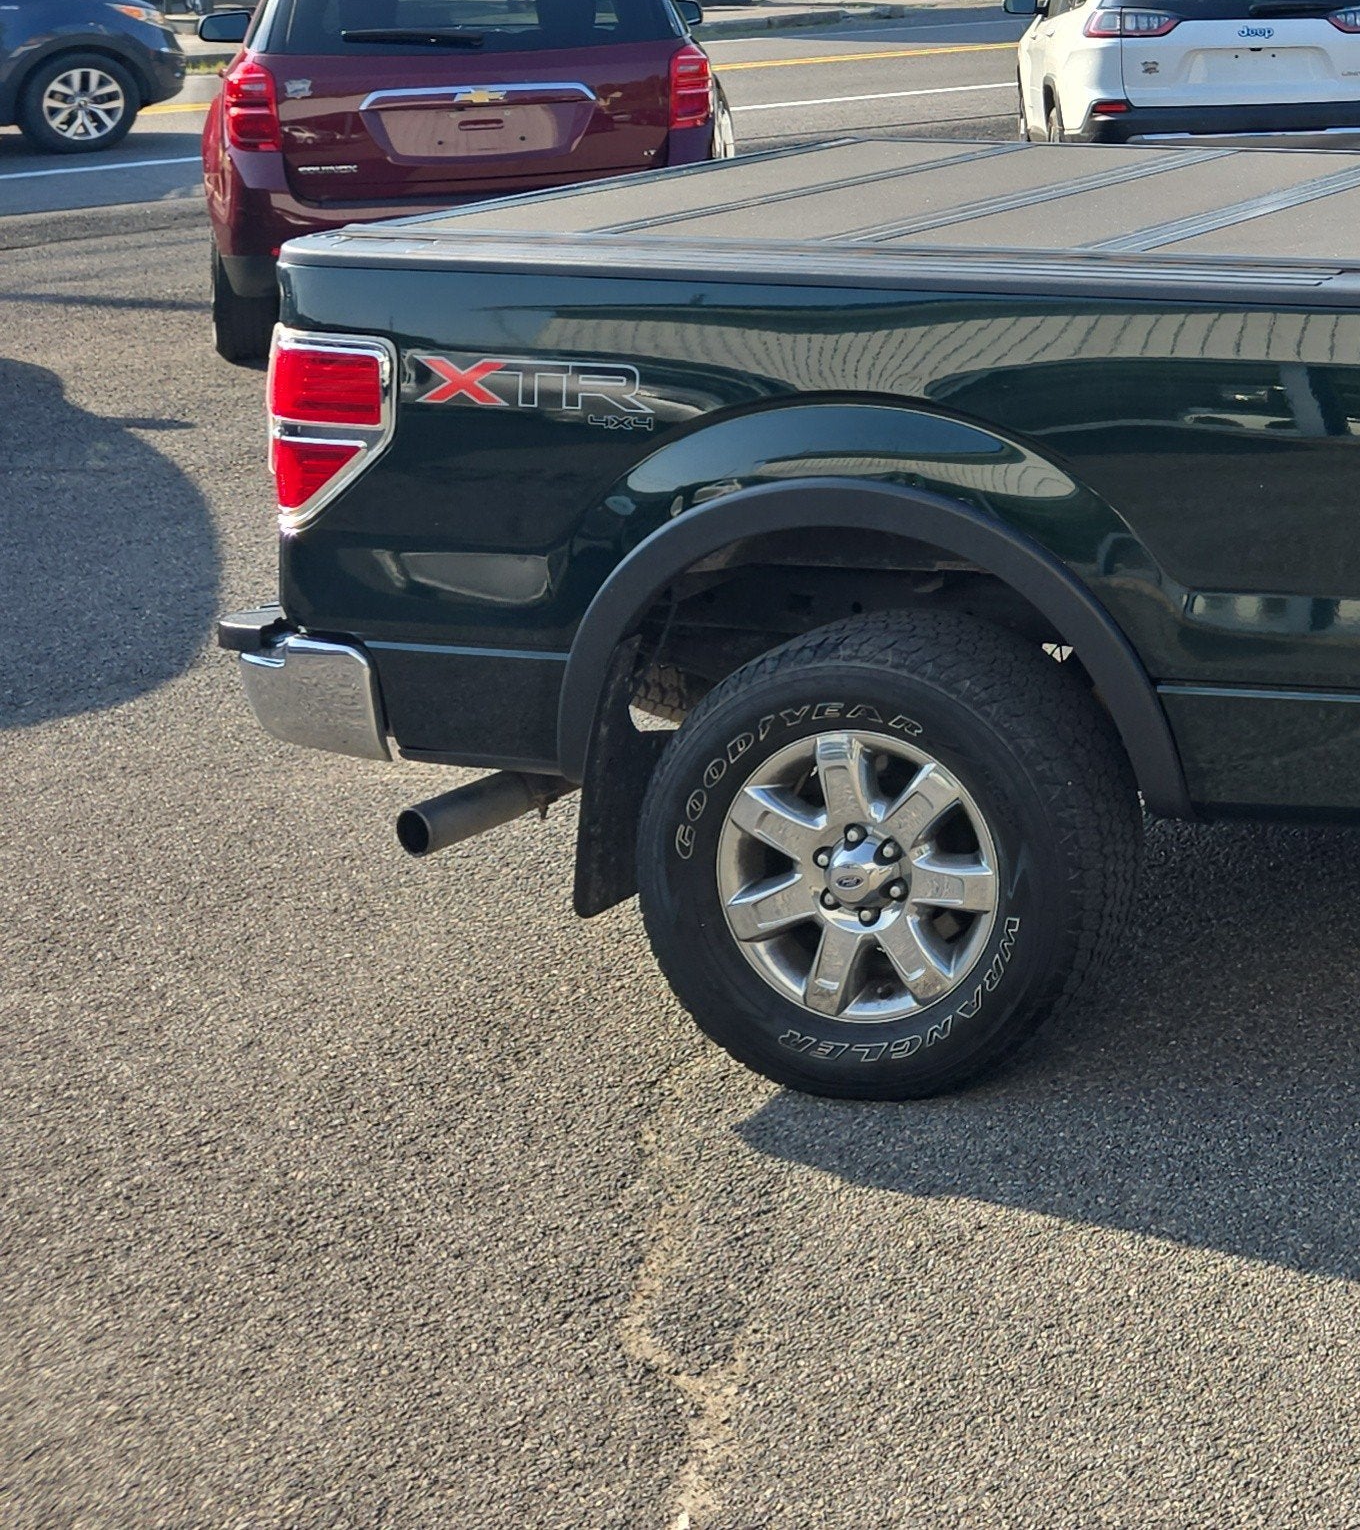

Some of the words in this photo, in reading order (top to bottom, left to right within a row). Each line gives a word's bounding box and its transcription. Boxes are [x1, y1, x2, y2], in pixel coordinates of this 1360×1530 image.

[1237, 25, 1275, 39] Jeep
[413, 355, 656, 413] XTR
[675, 701, 924, 861] GOODYEAR
[779, 916, 1022, 1063] WRANGLER
